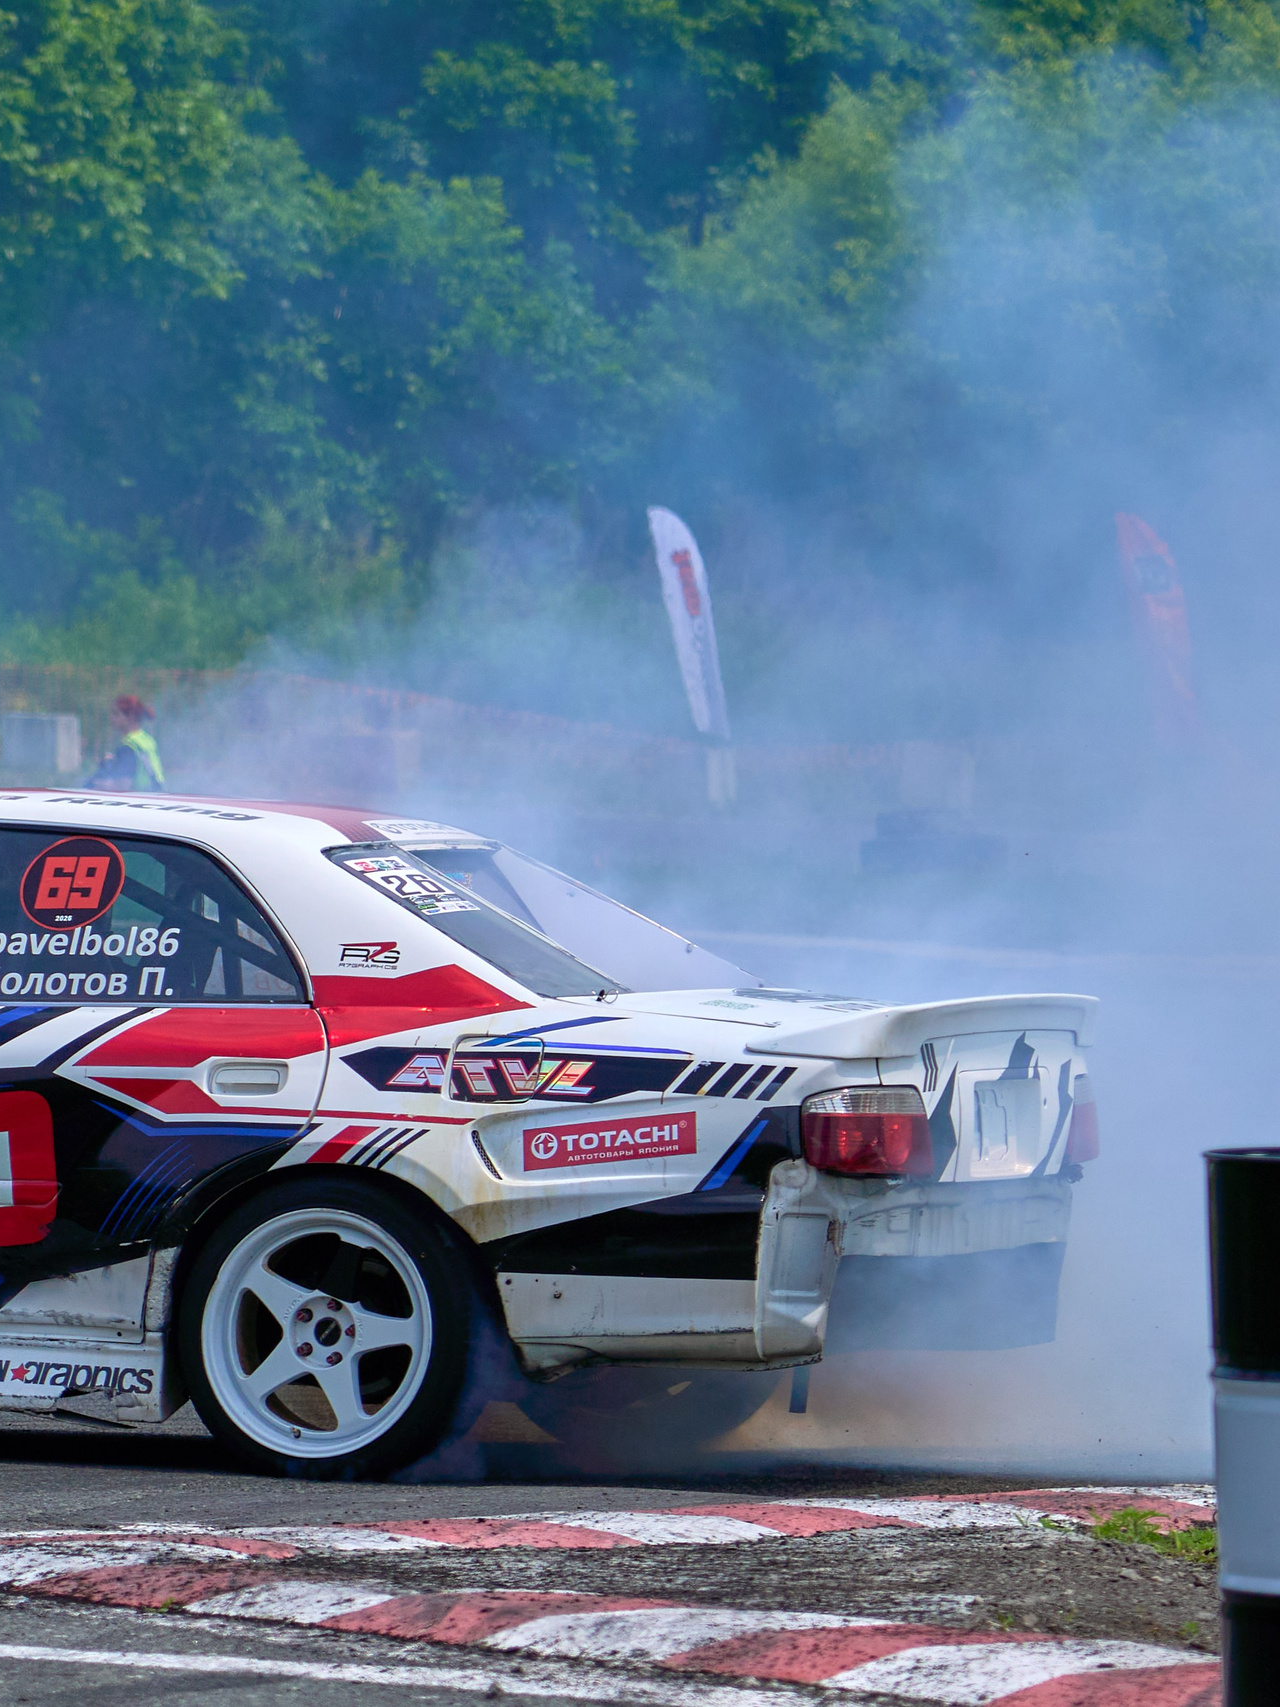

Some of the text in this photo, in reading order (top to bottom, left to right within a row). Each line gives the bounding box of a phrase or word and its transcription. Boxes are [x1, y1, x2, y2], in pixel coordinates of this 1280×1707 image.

[43, 796, 265, 821] Racing
[34, 856, 111, 910] 69
[380, 873, 447, 897] 26
[138, 966, 174, 996] П.
[561, 1124, 679, 1151] TOTACHI
[568, 1144, 679, 1162] АВТОТОВАРЫ ЯПОНИЯ
